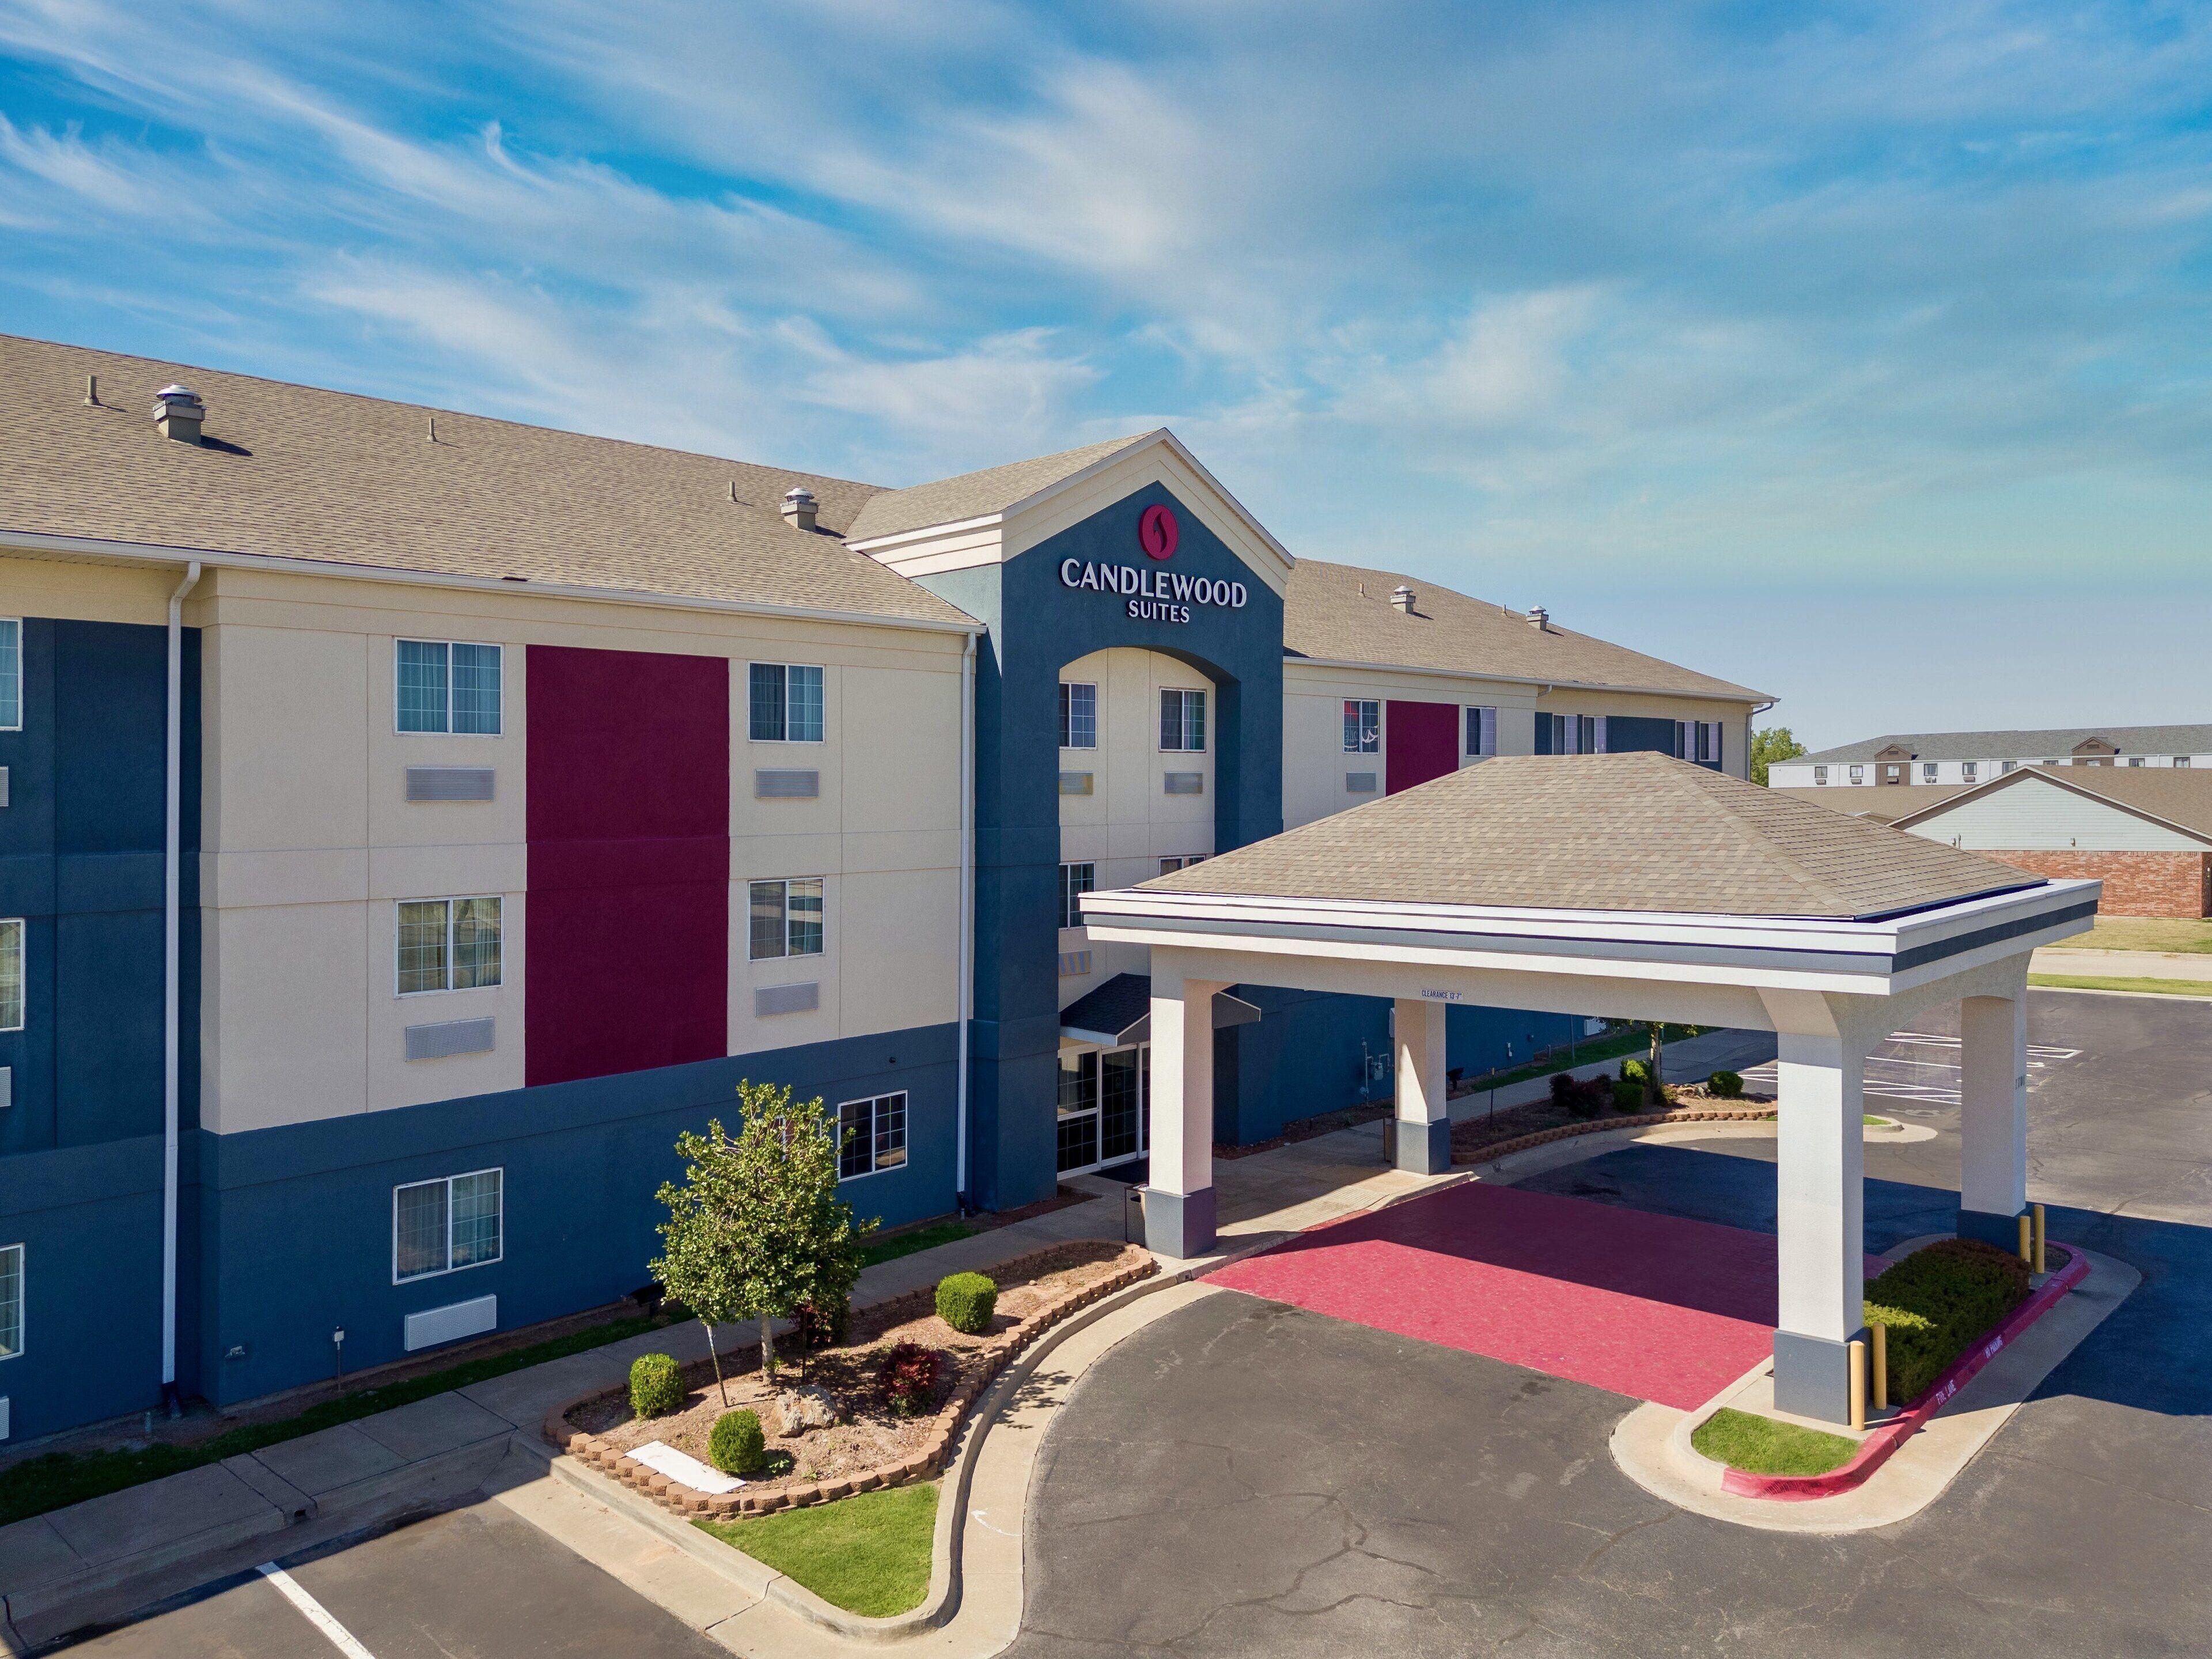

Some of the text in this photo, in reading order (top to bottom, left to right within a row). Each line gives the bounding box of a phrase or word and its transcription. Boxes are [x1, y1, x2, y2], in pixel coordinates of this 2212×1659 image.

[1061, 558, 1247, 608] CANDLEWOOD
[1127, 600, 1190, 623] SUITES
[1421, 990, 1448, 999] CLEARANCE
[1936, 1379, 1956, 1404] FIRE LANE
